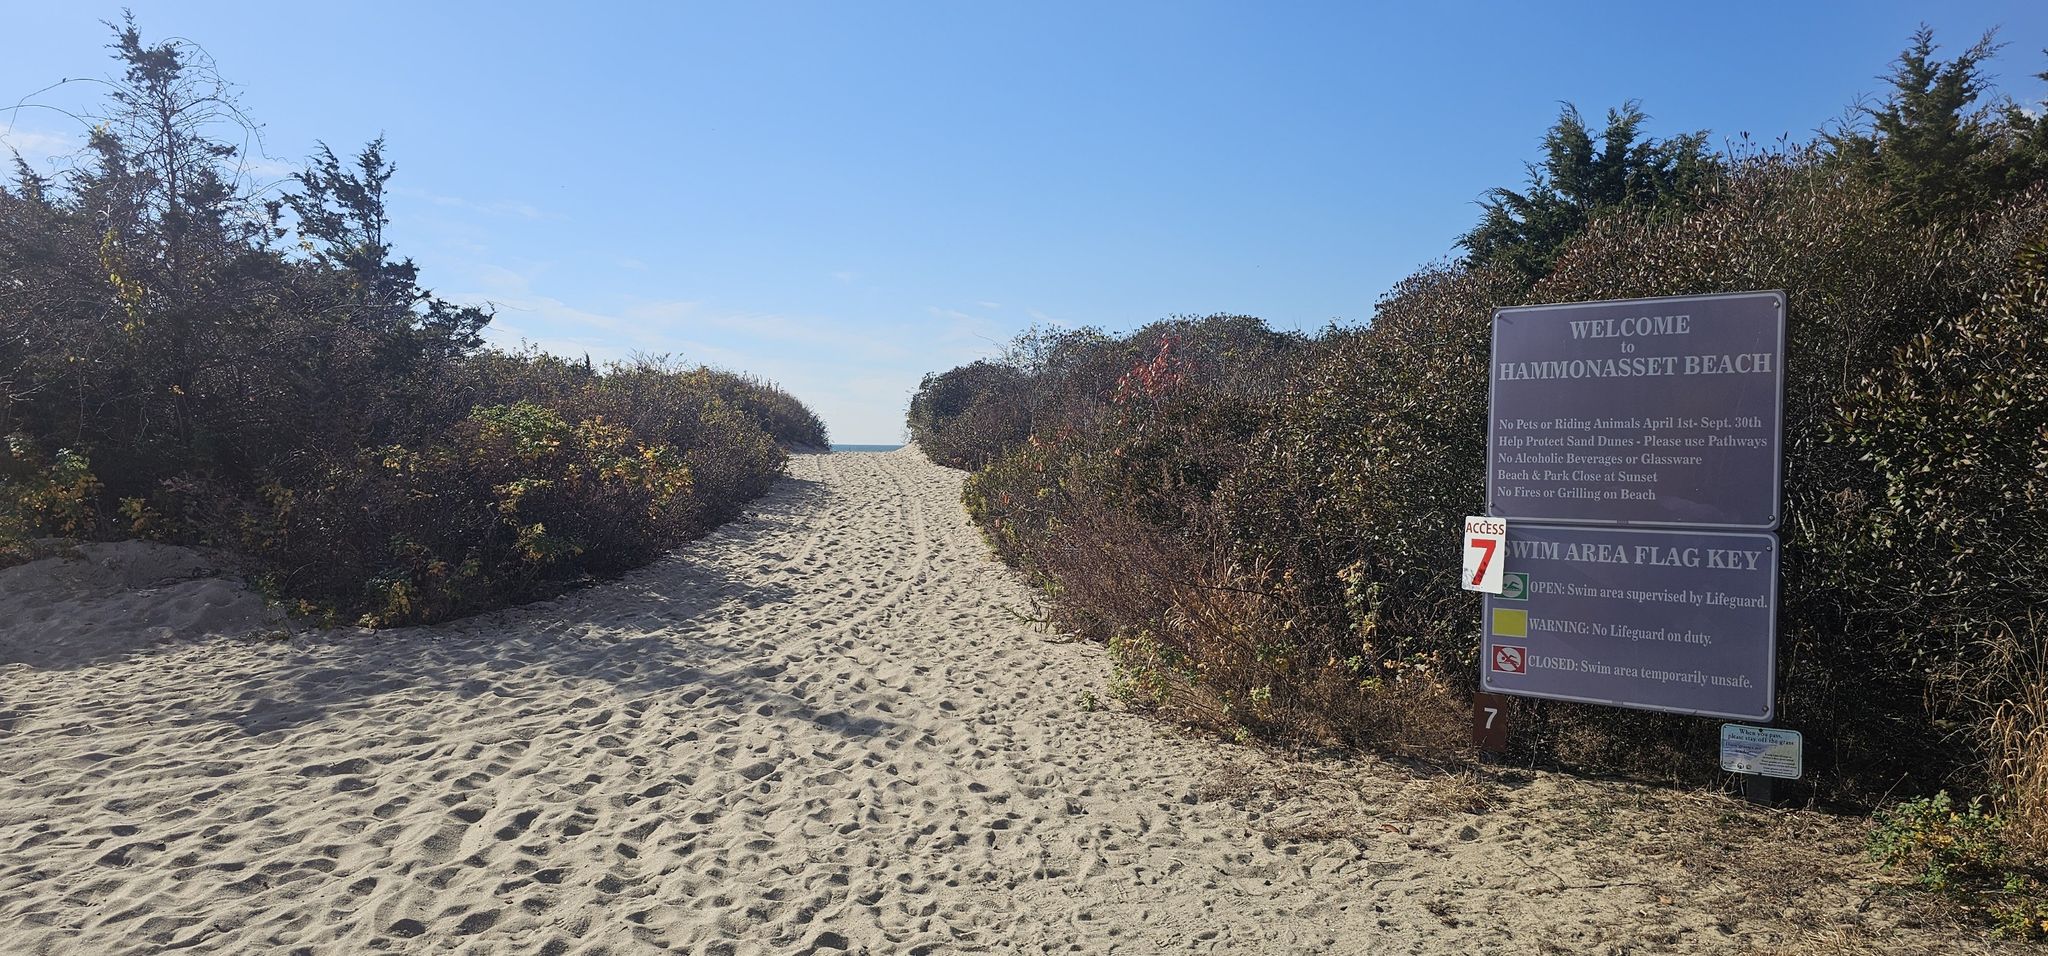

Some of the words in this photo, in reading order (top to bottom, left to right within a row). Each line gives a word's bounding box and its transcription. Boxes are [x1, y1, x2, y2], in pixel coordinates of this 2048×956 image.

[1569, 315, 1690, 339] WELCOME
[1621, 341, 1635, 354] to
[1499, 356, 1678, 380] HAMMONASSET
[1684, 353, 1772, 375] BEACH
[1499, 420, 1514, 430] No
[1516, 419, 1538, 430] Pets
[1540, 421, 1552, 430] or
[1555, 418, 1591, 431] Riding
[1593, 417, 1640, 429] Animals
[1643, 417, 1673, 431] April
[1678, 417, 1698, 429] 1st-
[1700, 416, 1732, 430] Sept.
[1735, 416, 1762, 428] 30th
[1499, 436, 1523, 448] Help
[1526, 436, 1564, 447] Protect
[1566, 435, 1595, 447] Sand
[1597, 435, 1634, 447] Dunes
[1644, 435, 1682, 447] Please
[1685, 438, 1705, 447] use
[1708, 435, 1768, 449] Pathways
[1498, 452, 1513, 463] No
[1515, 452, 1564, 464] Alcoholic
[1566, 453, 1623, 466] Beverages
[1625, 455, 1638, 464] or
[1641, 453, 1703, 465] Glassware
[1498, 469, 1529, 480] Beach
[1531, 470, 1541, 480] &
[1544, 470, 1569, 481] Park
[1572, 470, 1601, 481] Close
[1604, 472, 1615, 481] at
[1618, 471, 1658, 482] Sunset
[1497, 486, 1512, 497] No
[1514, 486, 1541, 498] Fires
[1543, 489, 1555, 498] or
[1557, 487, 1601, 501] Grilling
[1603, 490, 1617, 499] on
[1621, 489, 1656, 500] Beach
[1465, 522, 1505, 535] ACCESS
[1471, 538, 1497, 586] 7
[1564, 543, 1629, 564] AREA
[1634, 545, 1701, 568] FLAG
[1706, 549, 1762, 571] KEY
[1530, 580, 1565, 595] OPEN:
[1567, 583, 1597, 597] Swim
[1600, 588, 1624, 599] area
[1626, 588, 1687, 603] supervised
[1689, 590, 1703, 607] by
[1706, 592, 1768, 609] Lifeguard.
[1529, 618, 1589, 634] WARNING:
[1592, 623, 1607, 636] No
[1610, 624, 1665, 641] Lifeguard
[1667, 631, 1681, 642] on
[1684, 630, 1712, 647] duty.
[1528, 655, 1578, 671] CLOSED:
[1580, 659, 1611, 675] Swim
[1614, 664, 1638, 677] area
[1641, 667, 1708, 687] temporarily
[1711, 674, 1753, 689] unsafe.
[1484, 707, 1498, 729] 7
